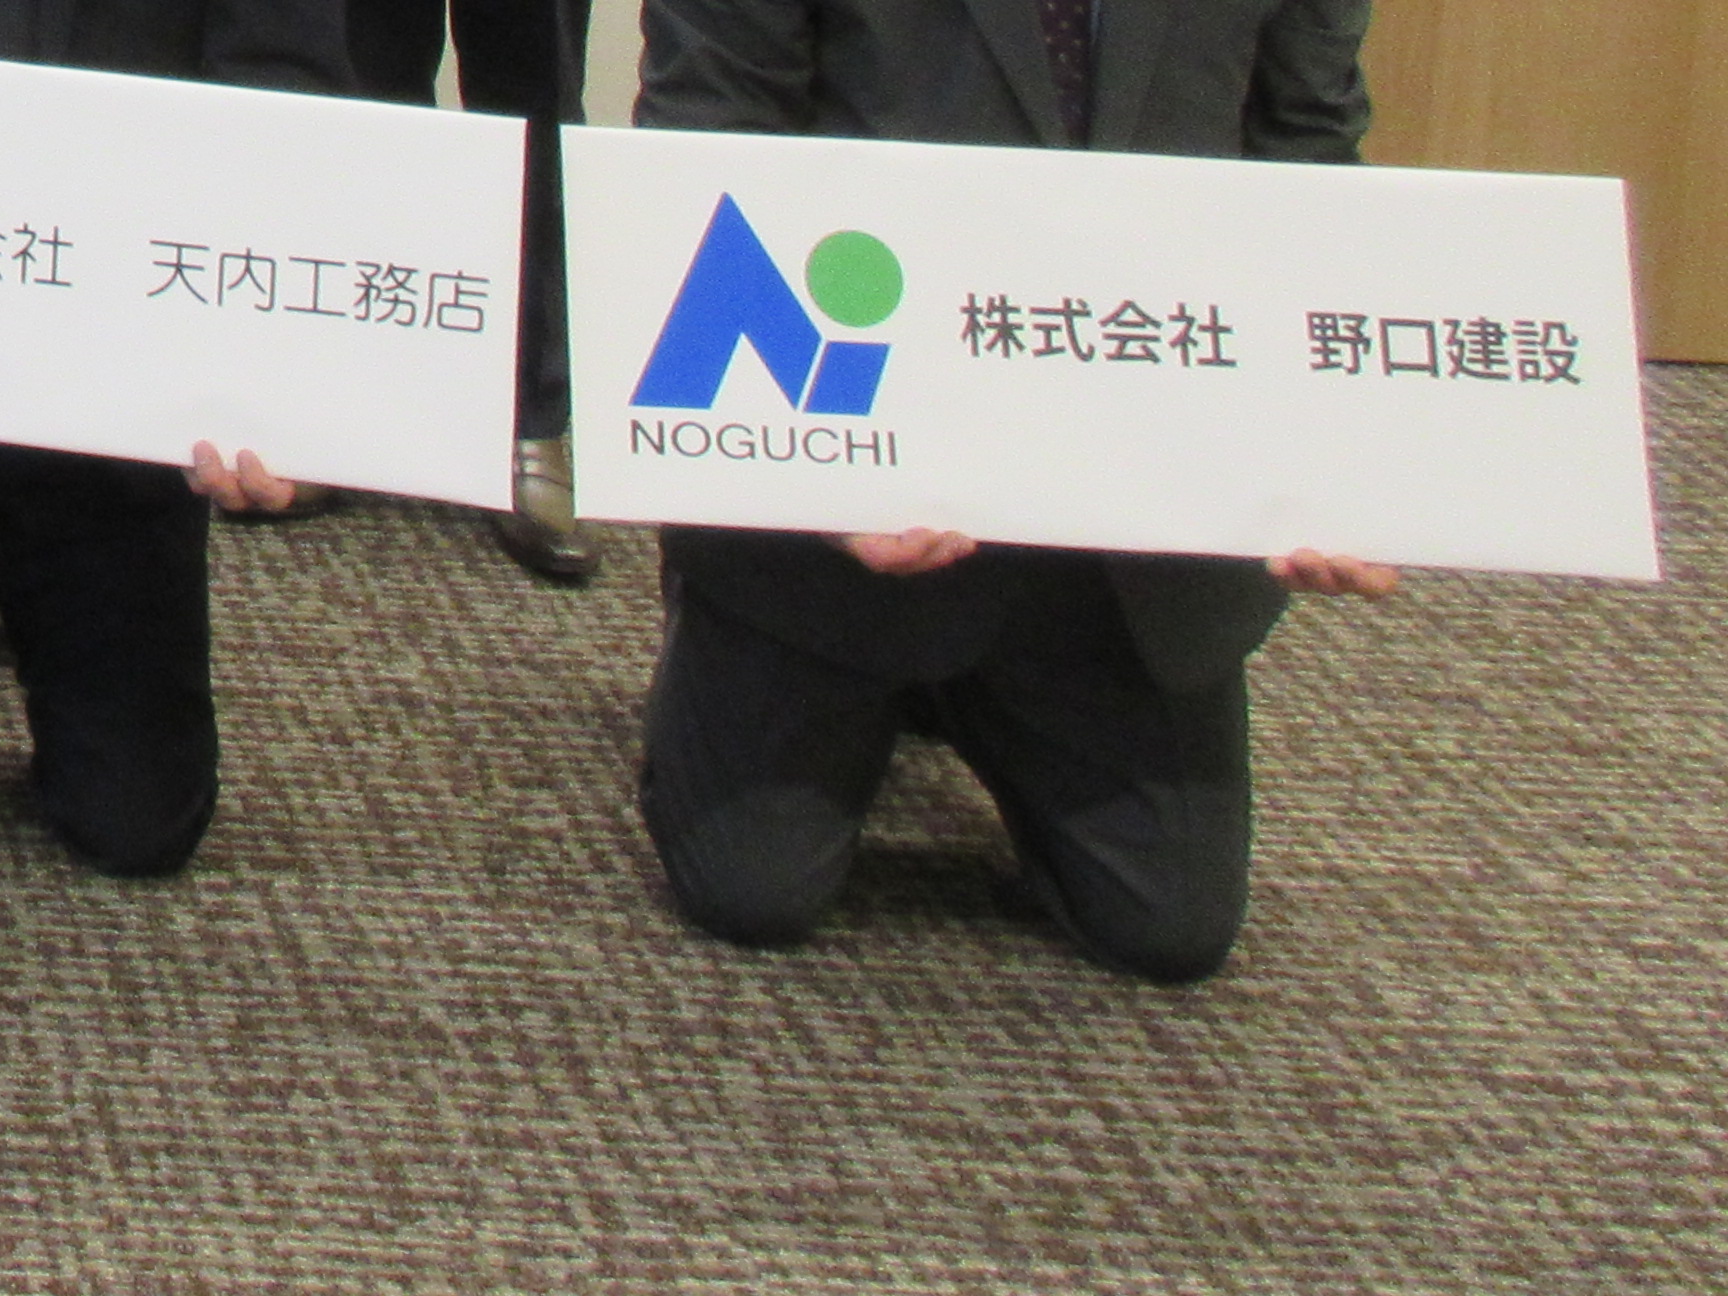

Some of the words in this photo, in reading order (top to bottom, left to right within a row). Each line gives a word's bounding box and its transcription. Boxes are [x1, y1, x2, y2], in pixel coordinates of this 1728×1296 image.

[146, 236, 490, 336] 天内工務店
[959, 291, 1238, 372] 株式会社
[1307, 309, 1583, 389] 野口建設
[630, 418, 900, 468] NOGUCHI
